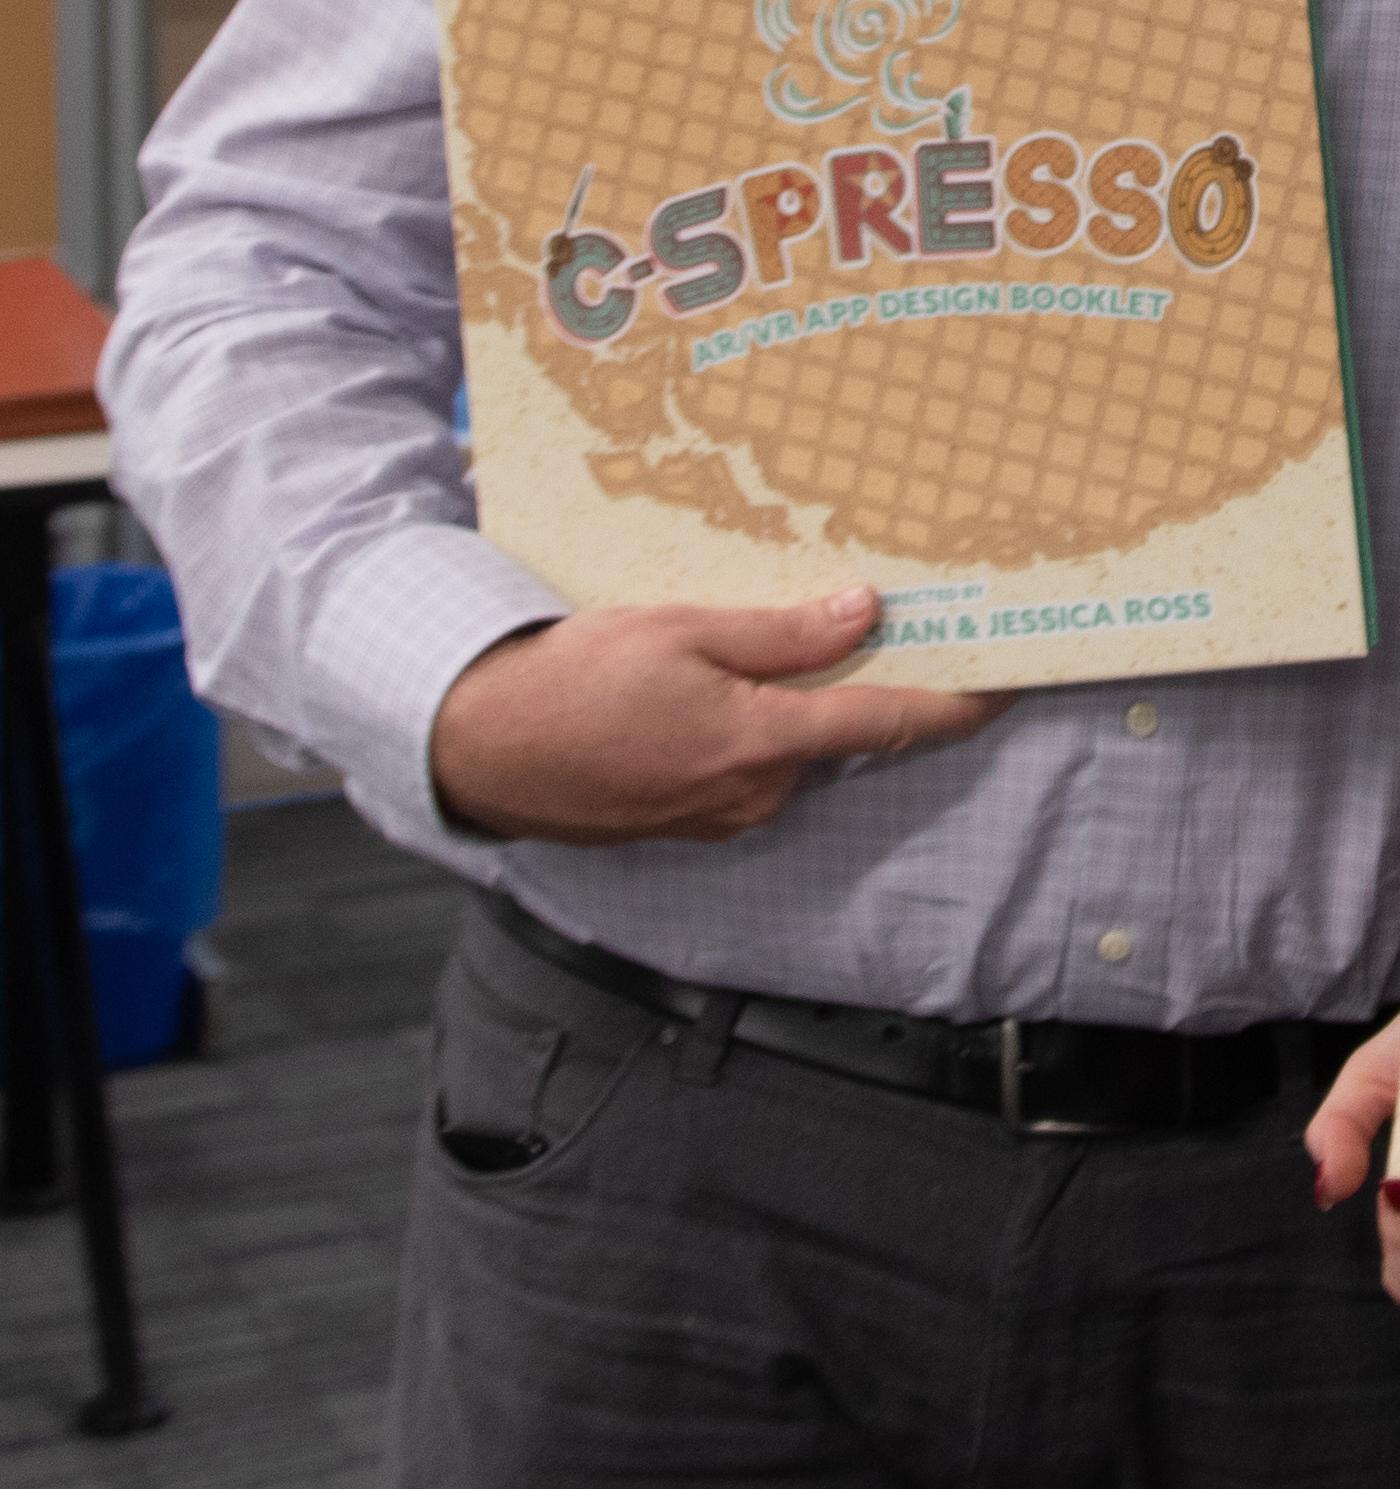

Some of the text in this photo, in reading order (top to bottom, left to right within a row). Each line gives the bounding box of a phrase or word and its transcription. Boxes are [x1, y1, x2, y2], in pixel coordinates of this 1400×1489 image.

[547, 134, 1254, 344] C-SPRESSO
[694, 286, 1170, 366] AR/VR APP DESIGN BOOKLET
[957, 614, 977, 639] &
[989, 601, 1115, 638] JESSICA
[1125, 592, 1212, 624] ROSS
